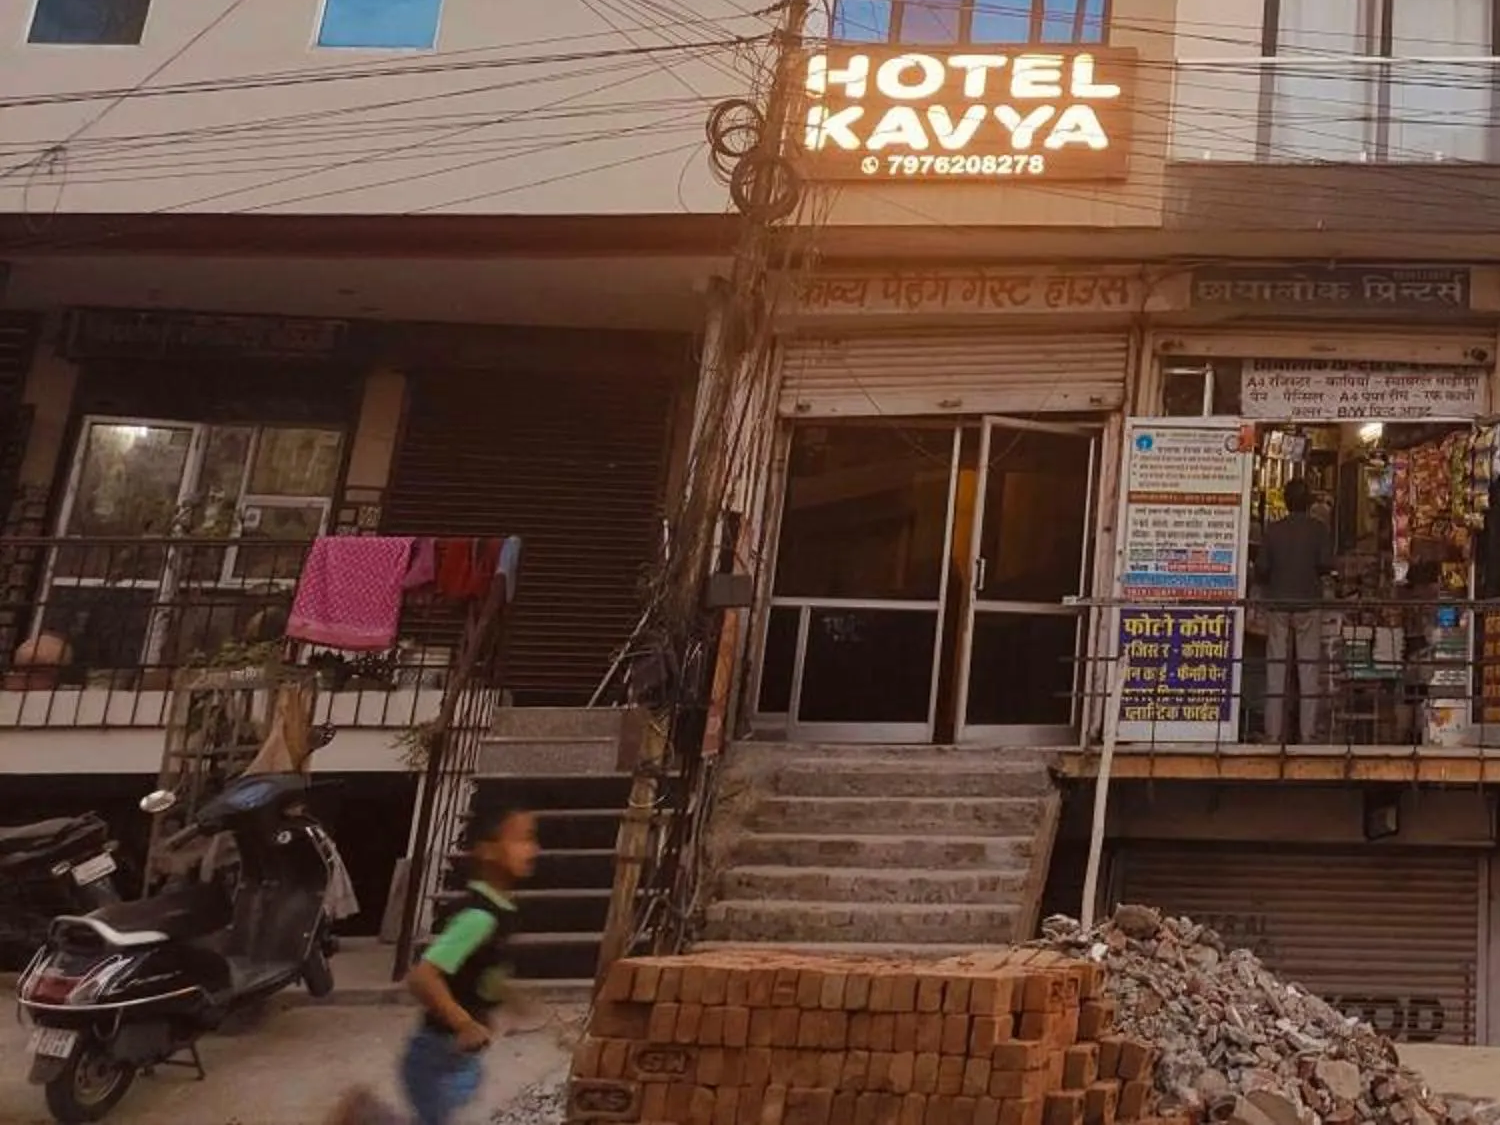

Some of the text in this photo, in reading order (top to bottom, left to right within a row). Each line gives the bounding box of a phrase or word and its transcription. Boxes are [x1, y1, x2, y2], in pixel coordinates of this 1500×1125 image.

[806, 53, 1121, 100] HOTEL
[805, 104, 1109, 151] KAVYA
[887, 154, 1045, 175] 7976208278
